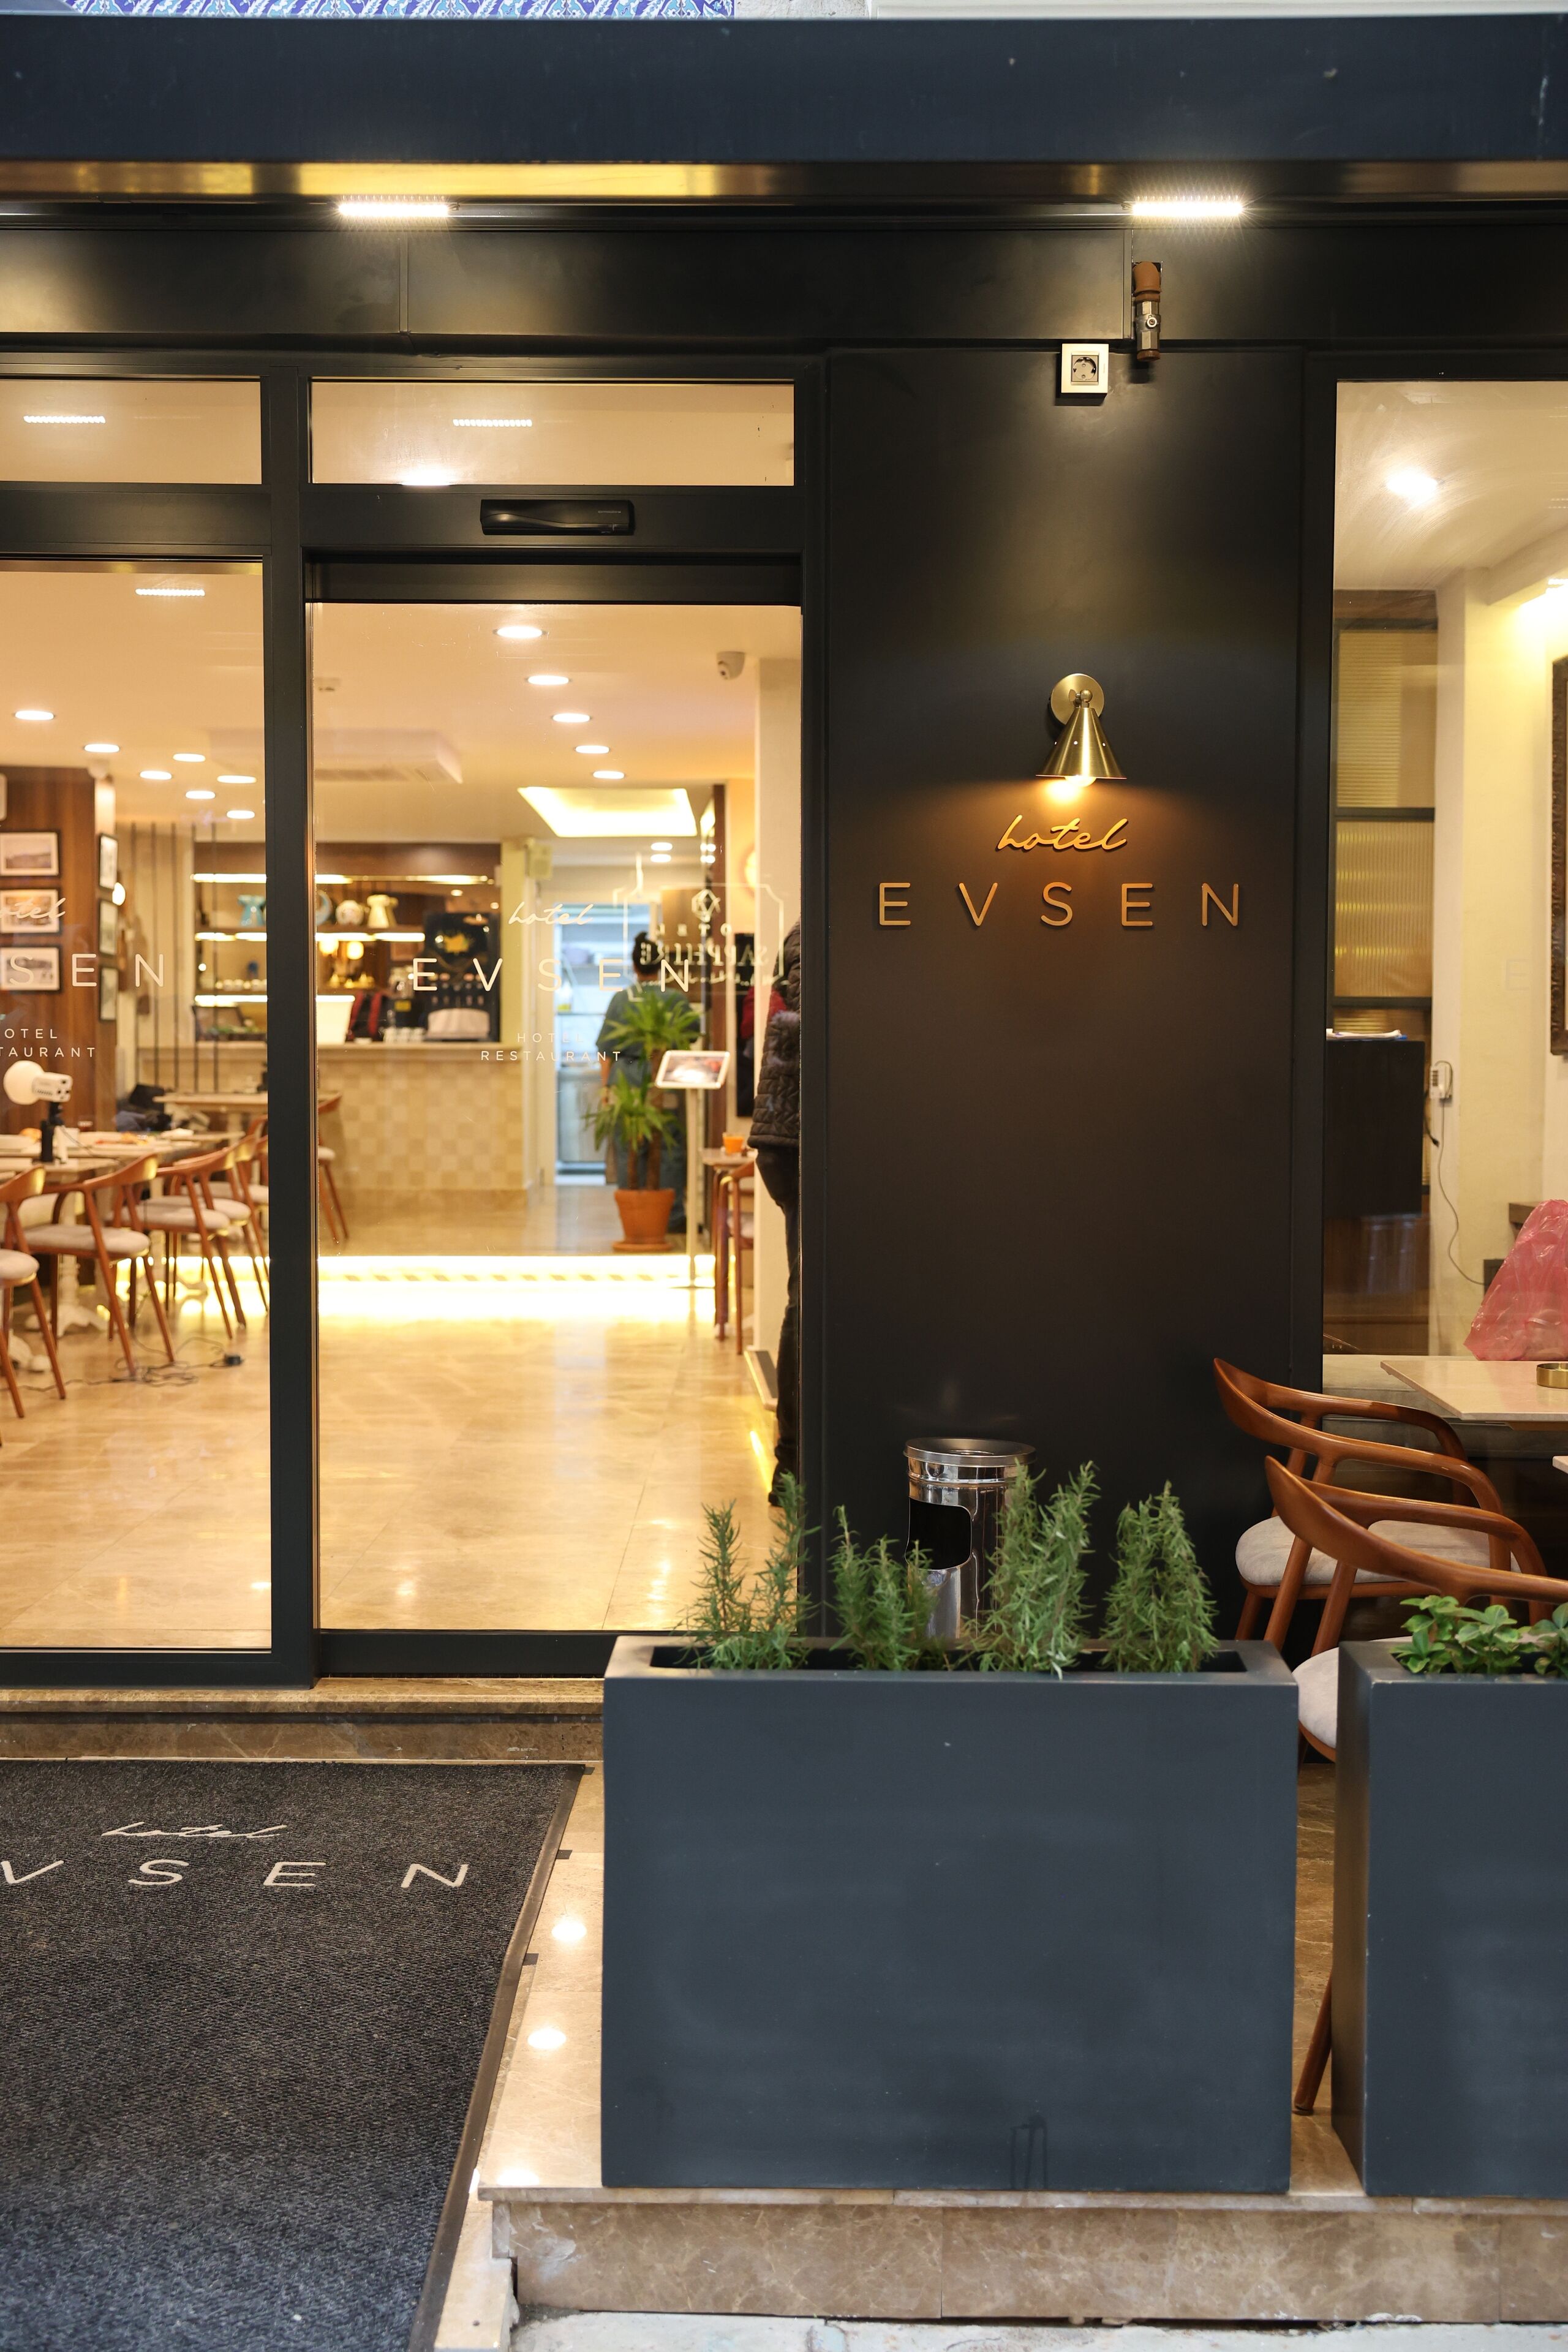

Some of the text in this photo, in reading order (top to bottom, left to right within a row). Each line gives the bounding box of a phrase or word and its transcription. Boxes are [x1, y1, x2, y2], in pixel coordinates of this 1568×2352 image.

[996, 815, 1129, 851] hotel
[508, 901, 594, 925] hotel
[878, 882, 1239, 927] EVSEN
[9, 954, 164, 988] SEN
[412, 957, 690, 992] EVSEN
[4, 1028, 58, 1039] OTEL
[517, 1033, 584, 1043] HOTEL
[480, 1050, 621, 1061] RESTAURANT
[102, 1822, 288, 1838] hotel
[0, 1860, 469, 1888] VSEN
